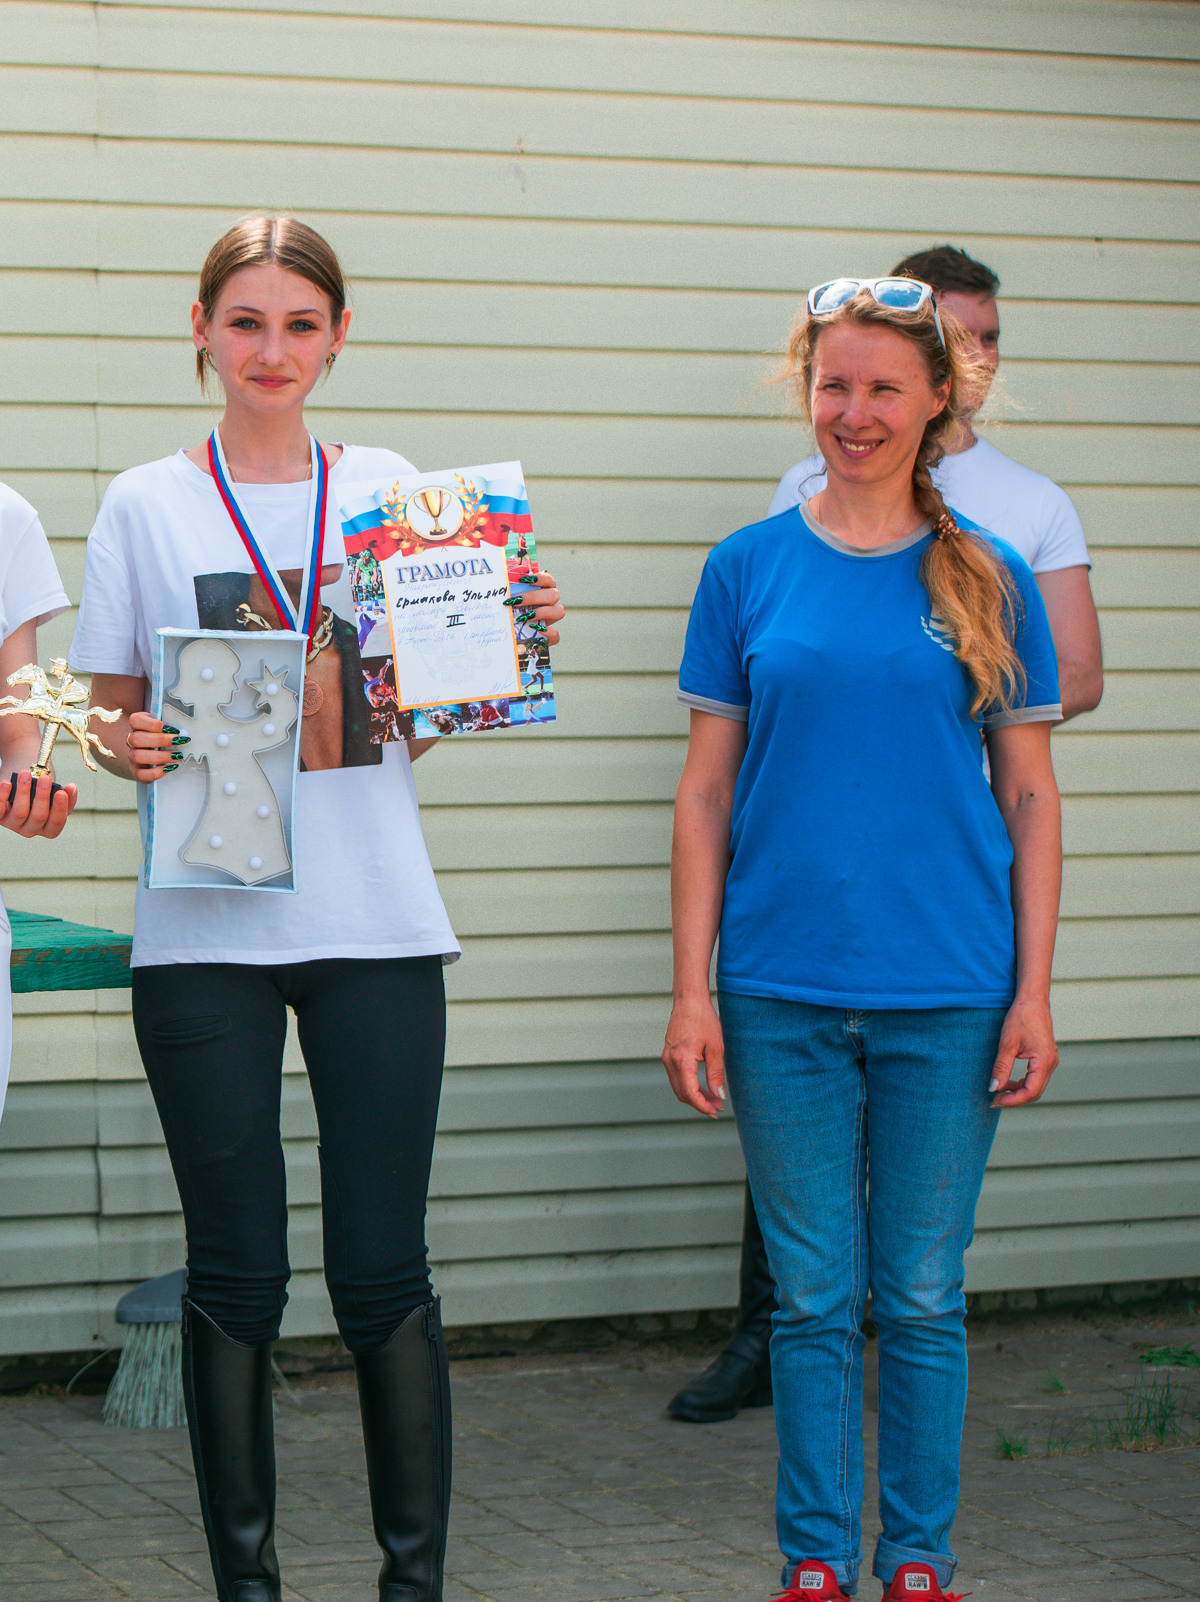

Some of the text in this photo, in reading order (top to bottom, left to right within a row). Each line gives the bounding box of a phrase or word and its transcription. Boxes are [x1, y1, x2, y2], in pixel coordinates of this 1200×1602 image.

[395, 558, 493, 584] ГРАМОТА
[396, 590, 456, 609] Ермакова
[462, 587, 508, 603] Ульяна
[446, 613, 467, 628] III
